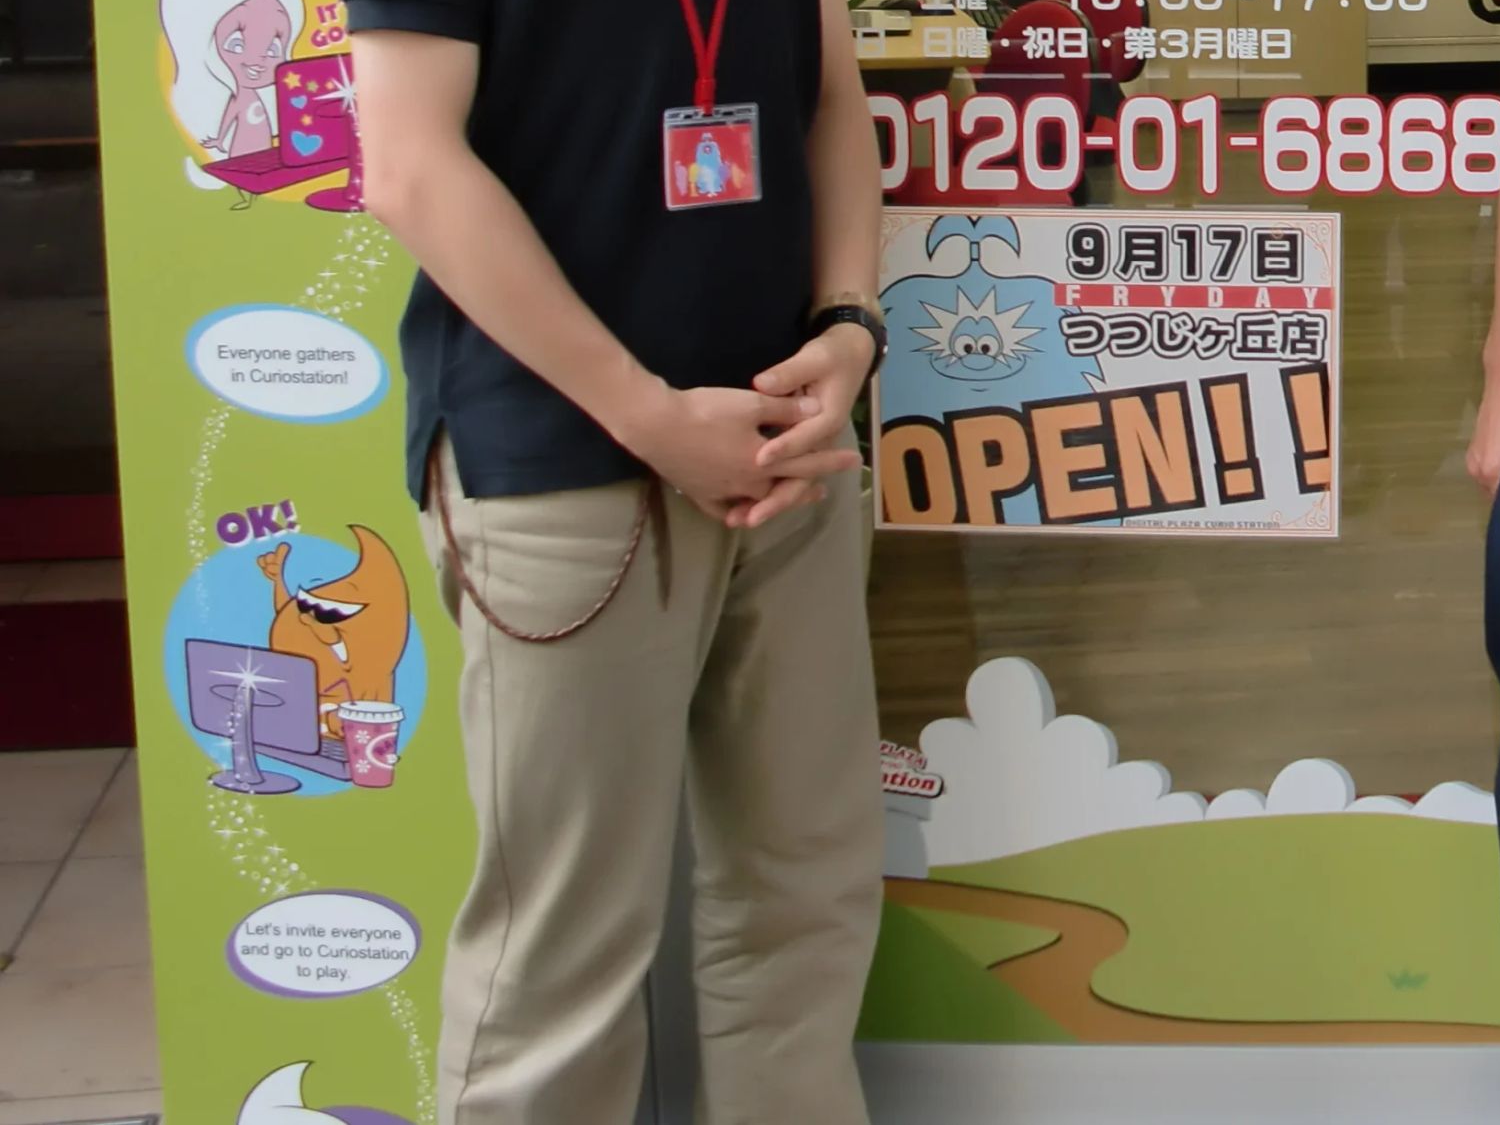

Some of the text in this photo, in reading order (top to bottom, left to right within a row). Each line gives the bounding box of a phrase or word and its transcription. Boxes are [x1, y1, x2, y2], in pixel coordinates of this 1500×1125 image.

[1065, 222, 1305, 284] 9月17日
[217, 344, 356, 365] Everyone gathers
[231, 368, 349, 386] in Curiostation!
[216, 498, 300, 547] OK!
[882, 773, 936, 792] tion
[245, 922, 402, 942] Let's invite everyone
[241, 942, 409, 961] and go to Curiostation
[296, 965, 350, 980] to play.
